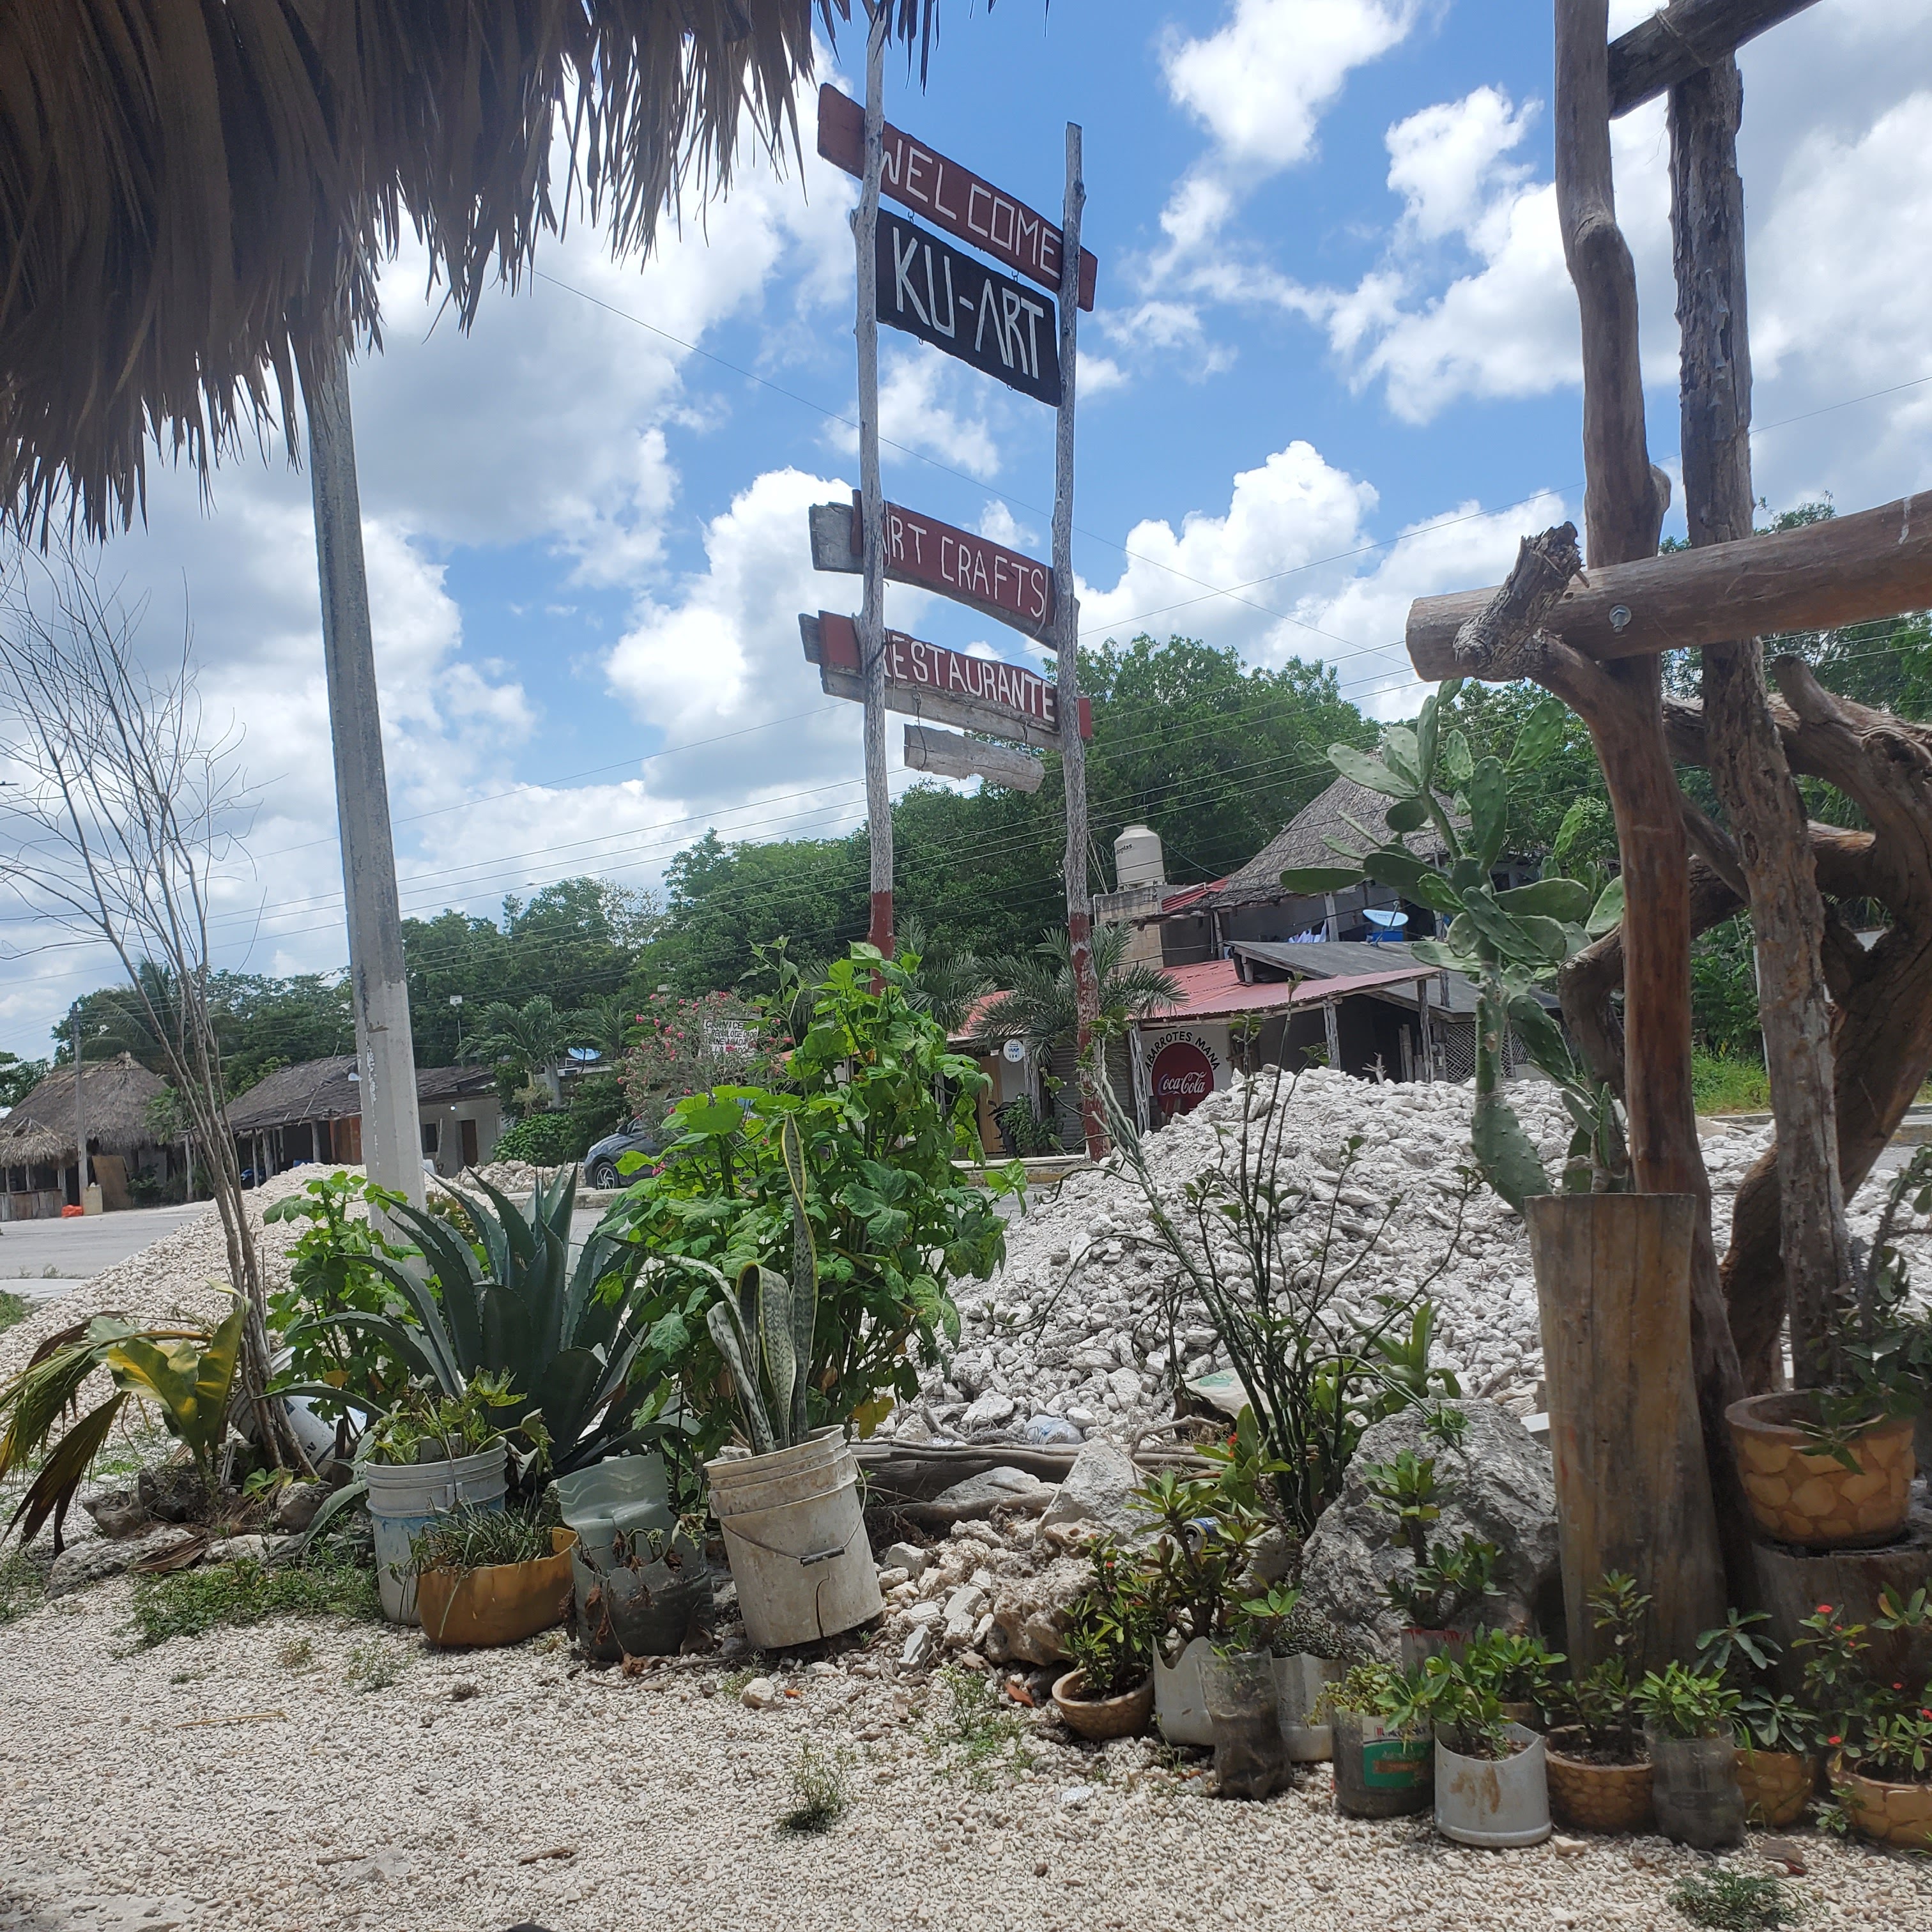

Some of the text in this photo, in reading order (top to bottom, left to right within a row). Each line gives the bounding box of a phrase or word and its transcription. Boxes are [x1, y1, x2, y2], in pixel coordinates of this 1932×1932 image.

[880, 139, 1062, 280] WELCOME
[893, 227, 1044, 379] KU-ART
[882, 515, 1044, 617] RT CRAFTS
[1145, 1031, 1220, 1073] ABARROTES MANA
[1158, 1071, 1207, 1096] Coca-Cola
